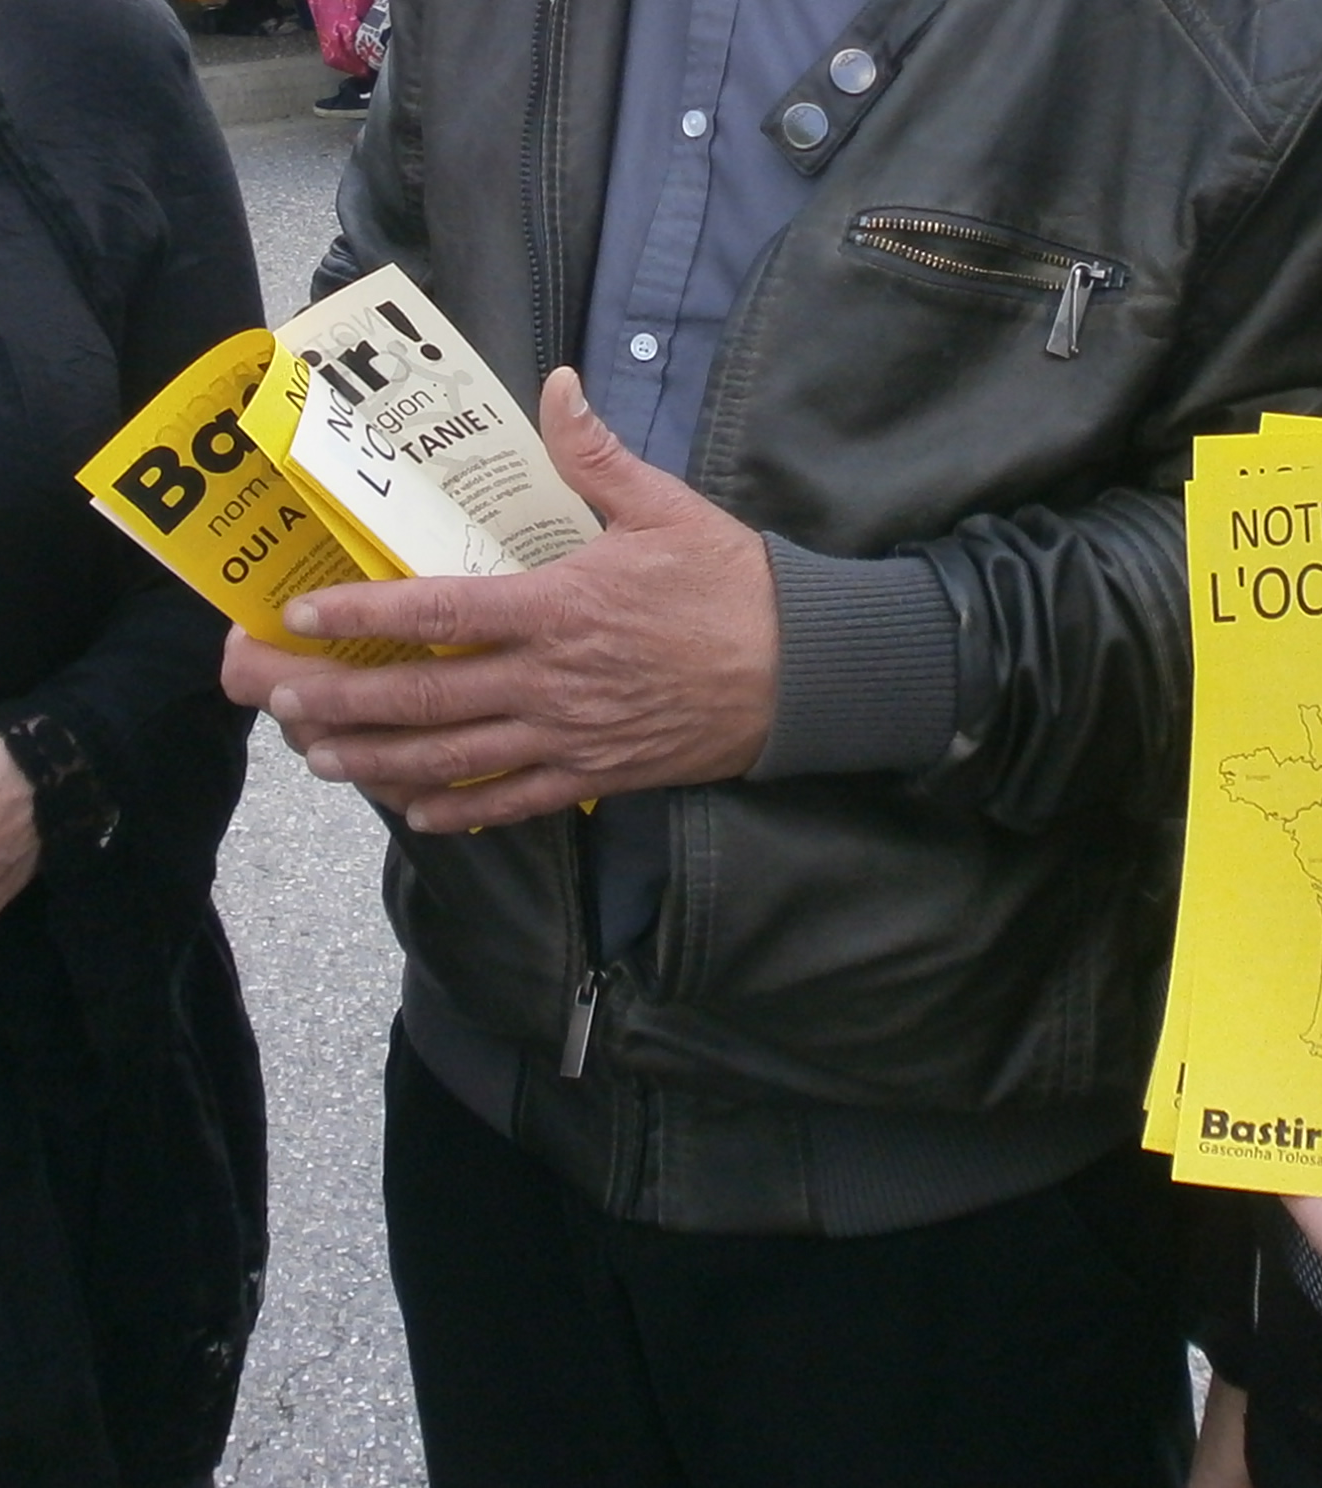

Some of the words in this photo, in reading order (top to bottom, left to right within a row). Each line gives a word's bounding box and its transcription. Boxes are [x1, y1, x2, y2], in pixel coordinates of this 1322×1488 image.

[207, 477, 269, 537] nom
[222, 526, 279, 584] OUI
[278, 505, 307, 531] A
[1198, 1142, 1272, 1161] Gasconha
[1200, 1108, 1322, 1151] Bastir
